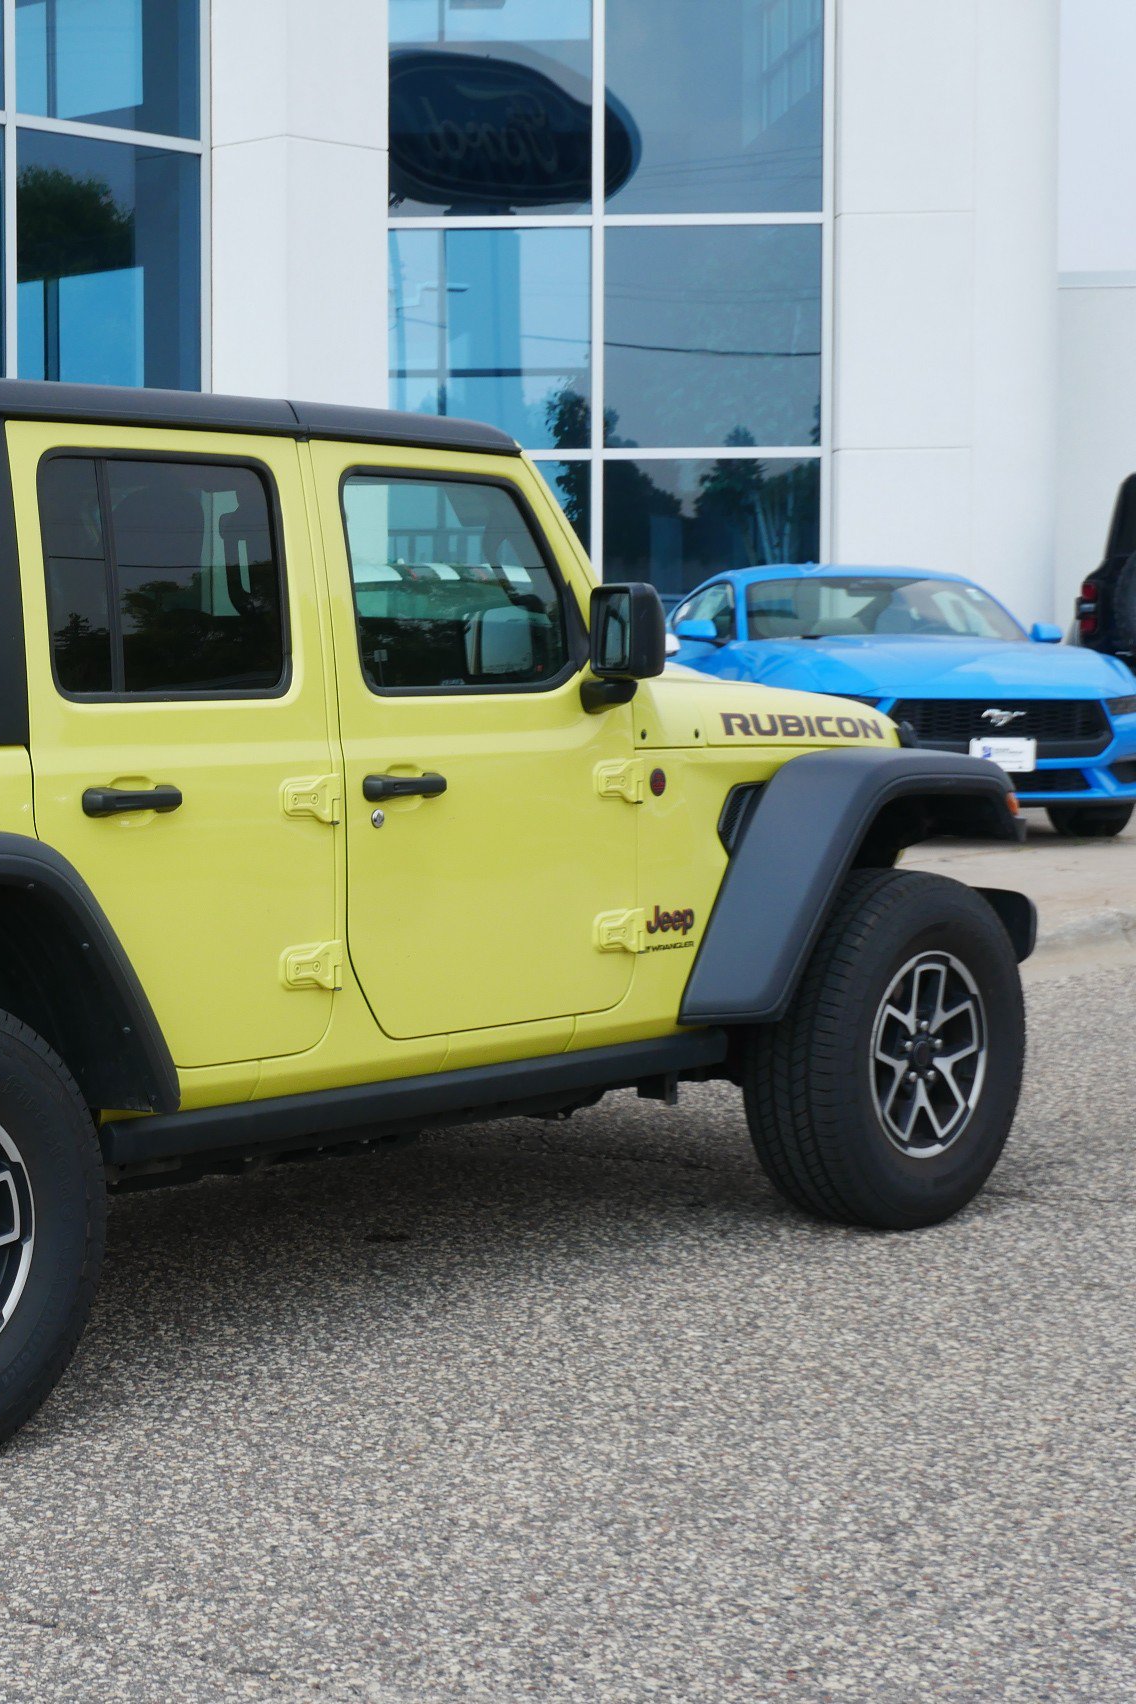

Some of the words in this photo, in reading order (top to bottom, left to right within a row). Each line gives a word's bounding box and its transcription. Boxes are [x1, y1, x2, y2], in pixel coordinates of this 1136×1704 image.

[719, 712, 884, 740] RUBICON
[646, 904, 695, 936] Jeep
[649, 940, 695, 952] WRANGLER
